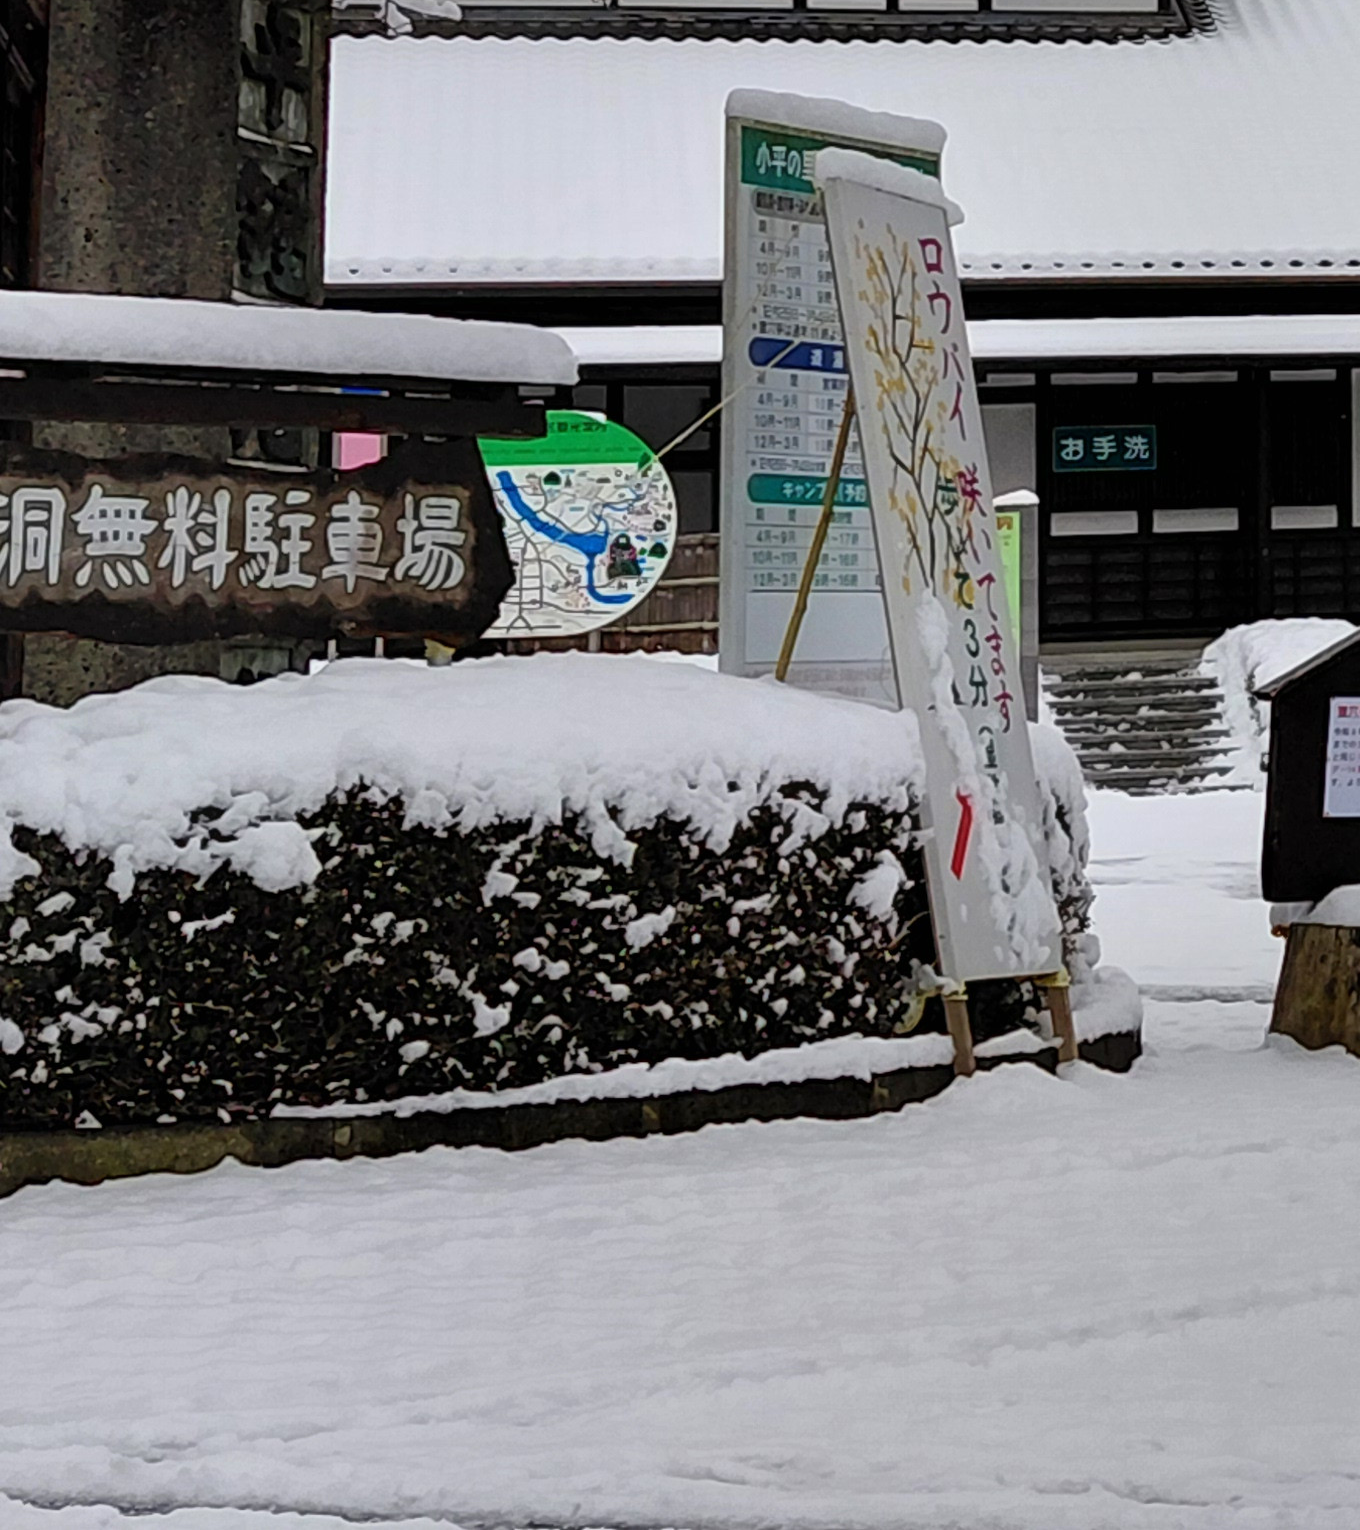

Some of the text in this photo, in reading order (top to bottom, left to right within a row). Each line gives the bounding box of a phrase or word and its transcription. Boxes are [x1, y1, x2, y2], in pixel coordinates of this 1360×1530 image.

[1059, 434, 1150, 462] お手洗
[0, 483, 467, 593] 洞無料駐車場
